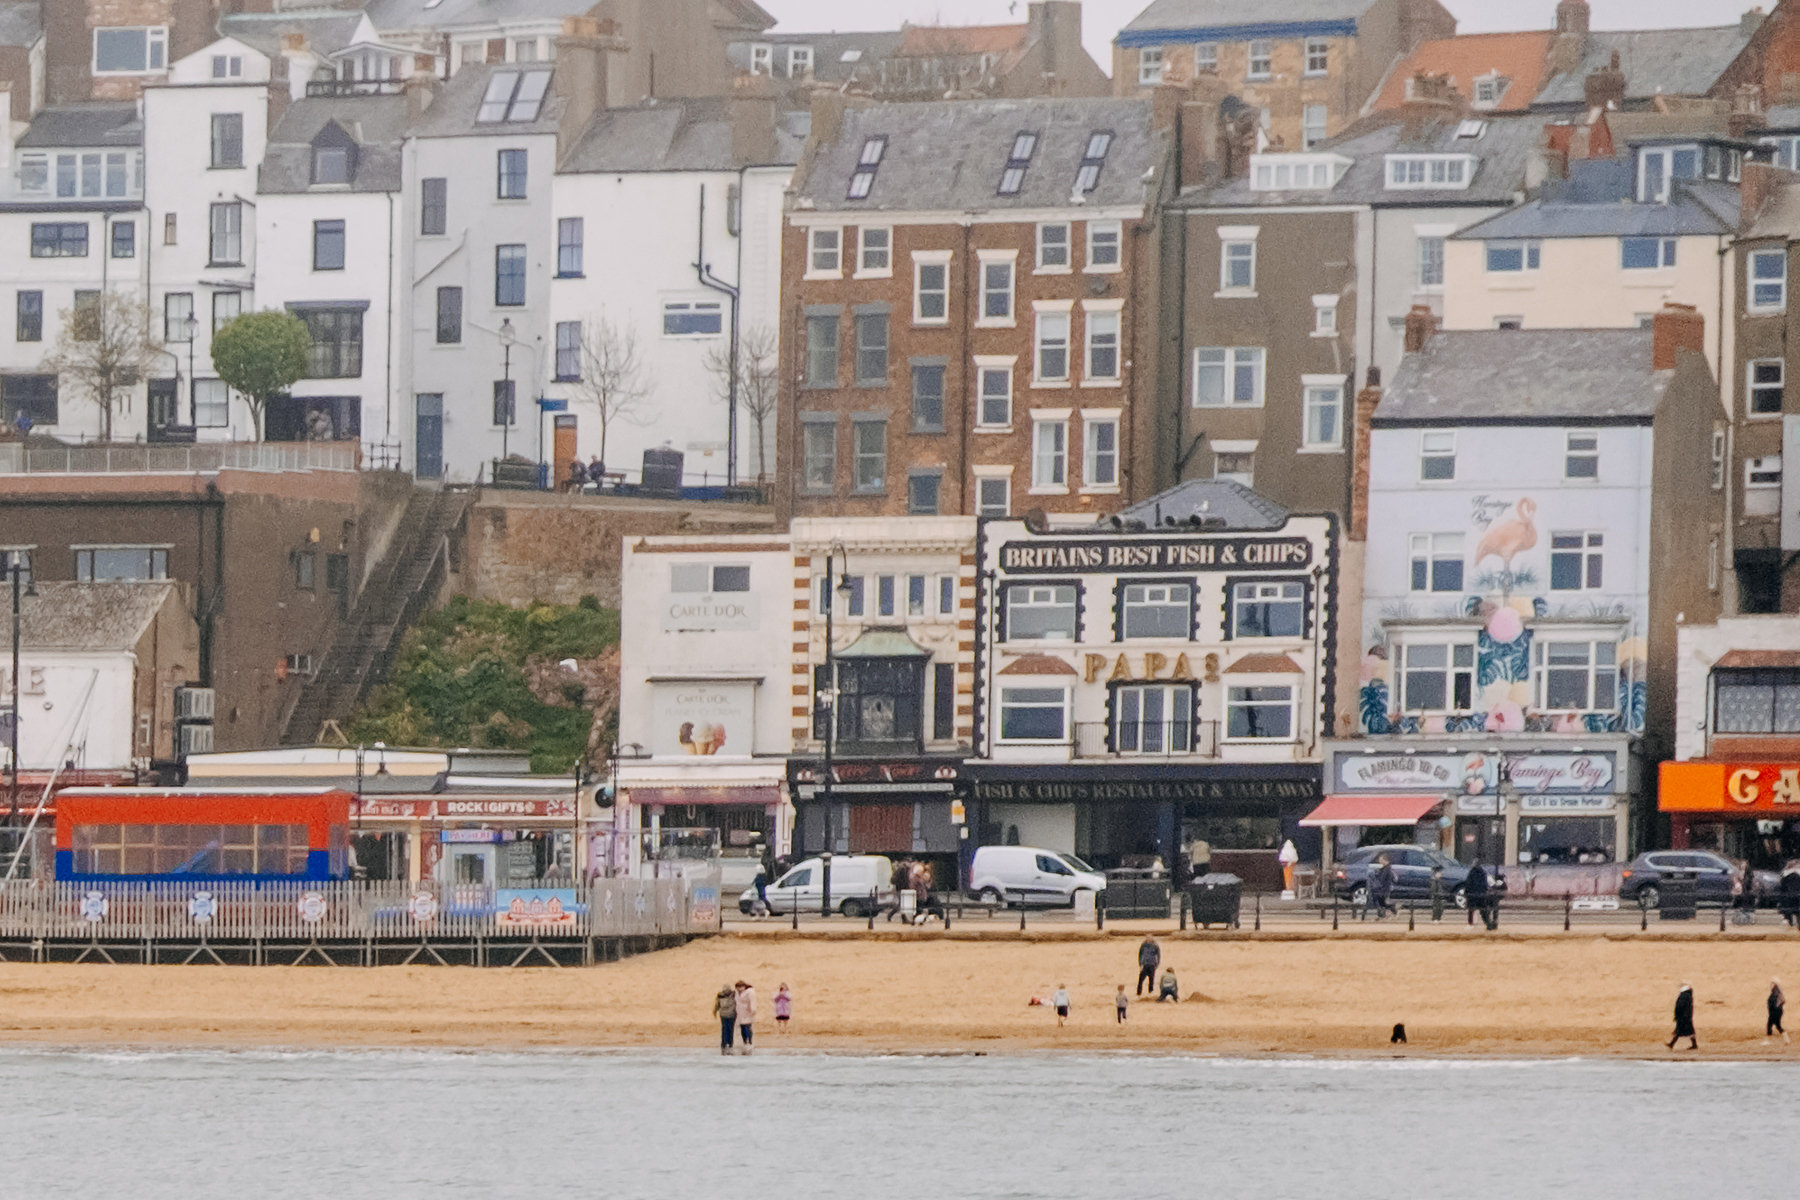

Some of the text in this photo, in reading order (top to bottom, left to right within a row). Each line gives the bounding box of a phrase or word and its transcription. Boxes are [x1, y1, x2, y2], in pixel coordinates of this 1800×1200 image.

[1005, 543, 1308, 567] BRITAINS BEST FISH & CHIPS
[670, 604, 711, 619] CARTE
[1357, 757, 1415, 781] FLAMINGO
[1569, 758, 1604, 792] Bay
[974, 783, 1014, 798] FISH
[1037, 783, 1087, 797] CHIPS
[1093, 782, 1205, 797] RESTAURANT
[448, 802, 525, 813] ROCK GIFTS
